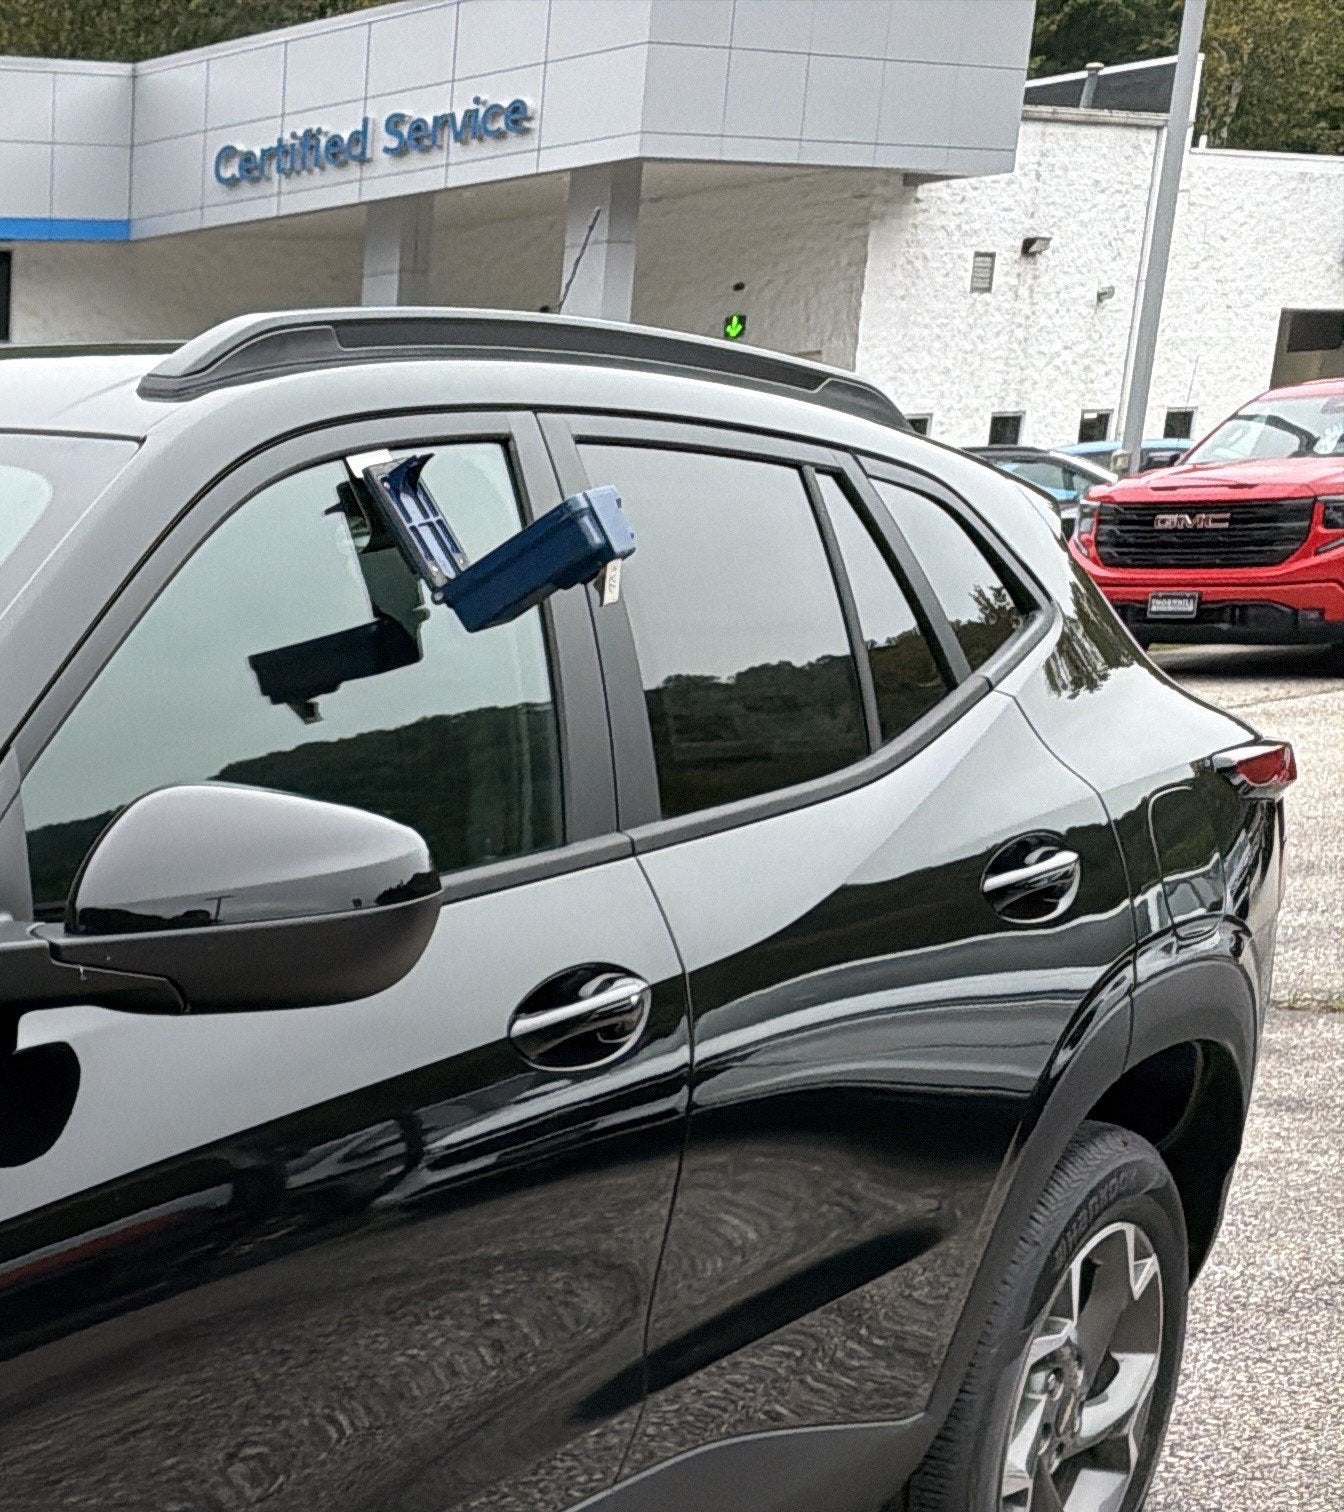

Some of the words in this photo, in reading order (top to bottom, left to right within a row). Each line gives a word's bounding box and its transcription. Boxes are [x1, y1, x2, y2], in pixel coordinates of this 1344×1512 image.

[214, 116, 370, 187] Certified
[382, 96, 530, 157] Service
[1154, 513, 1231, 530] GMC
